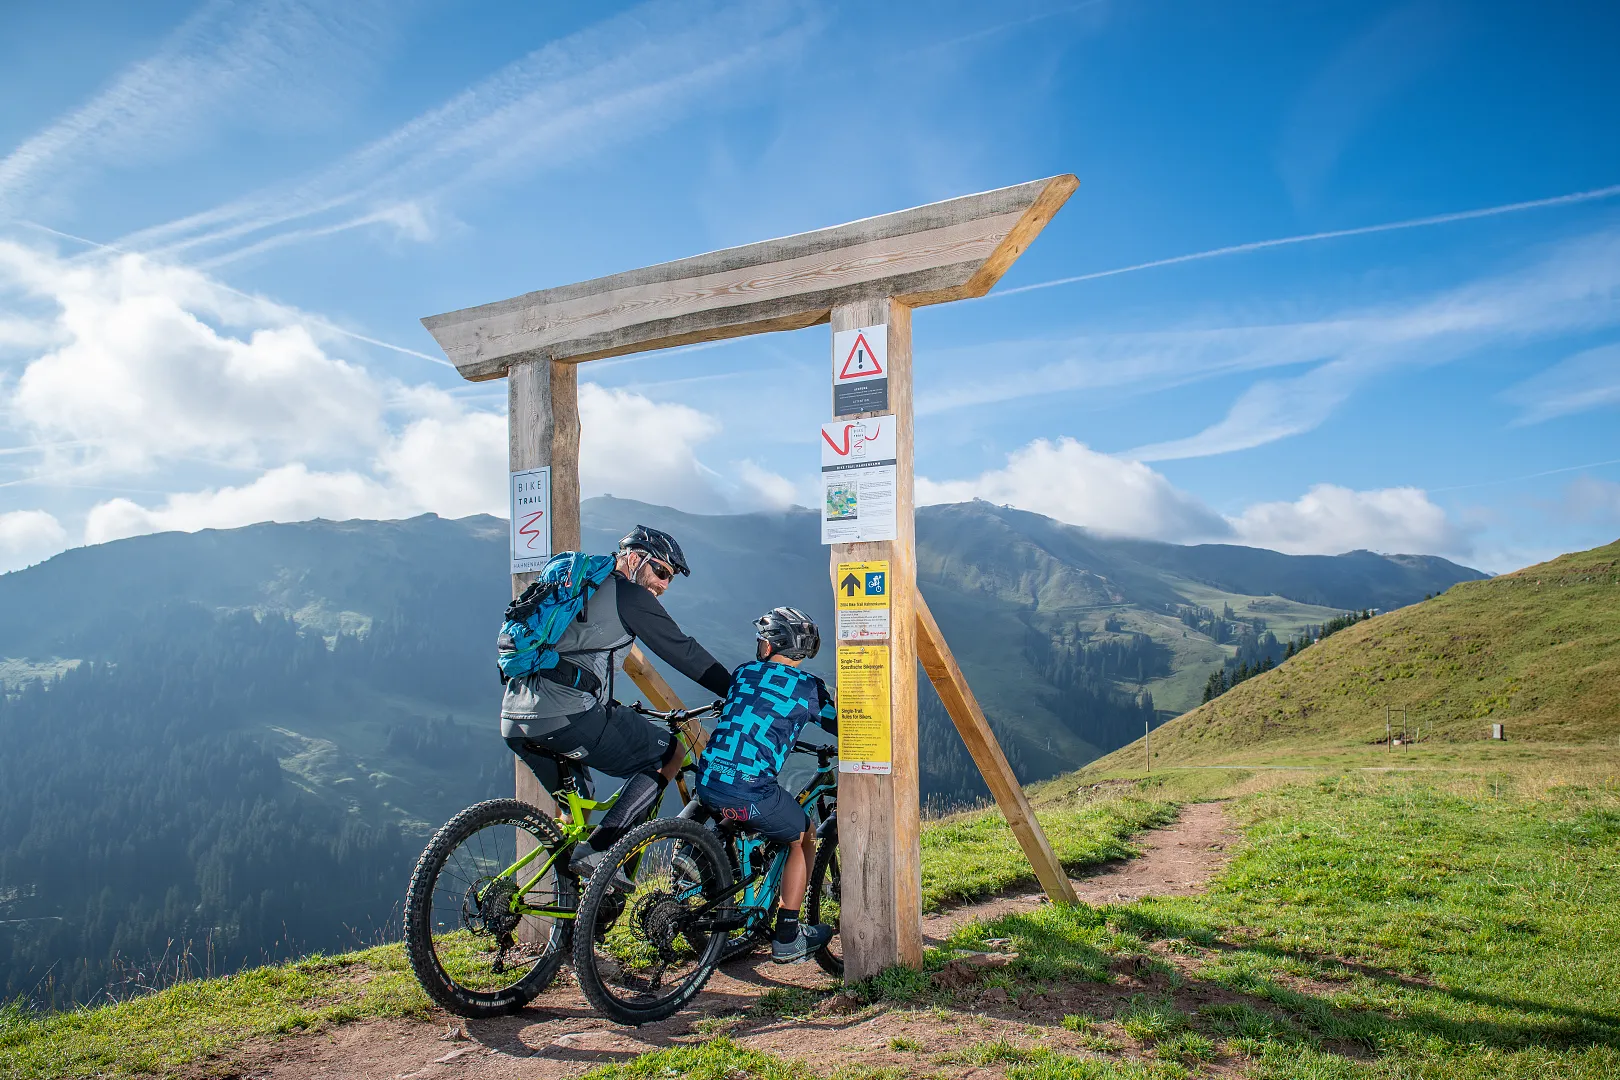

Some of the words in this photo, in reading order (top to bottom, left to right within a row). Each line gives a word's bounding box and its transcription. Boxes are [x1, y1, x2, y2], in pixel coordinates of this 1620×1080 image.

[518, 480, 541, 492] BIKE
[519, 496, 541, 505] TRAIL
[523, 814, 560, 843] MAXXIS
